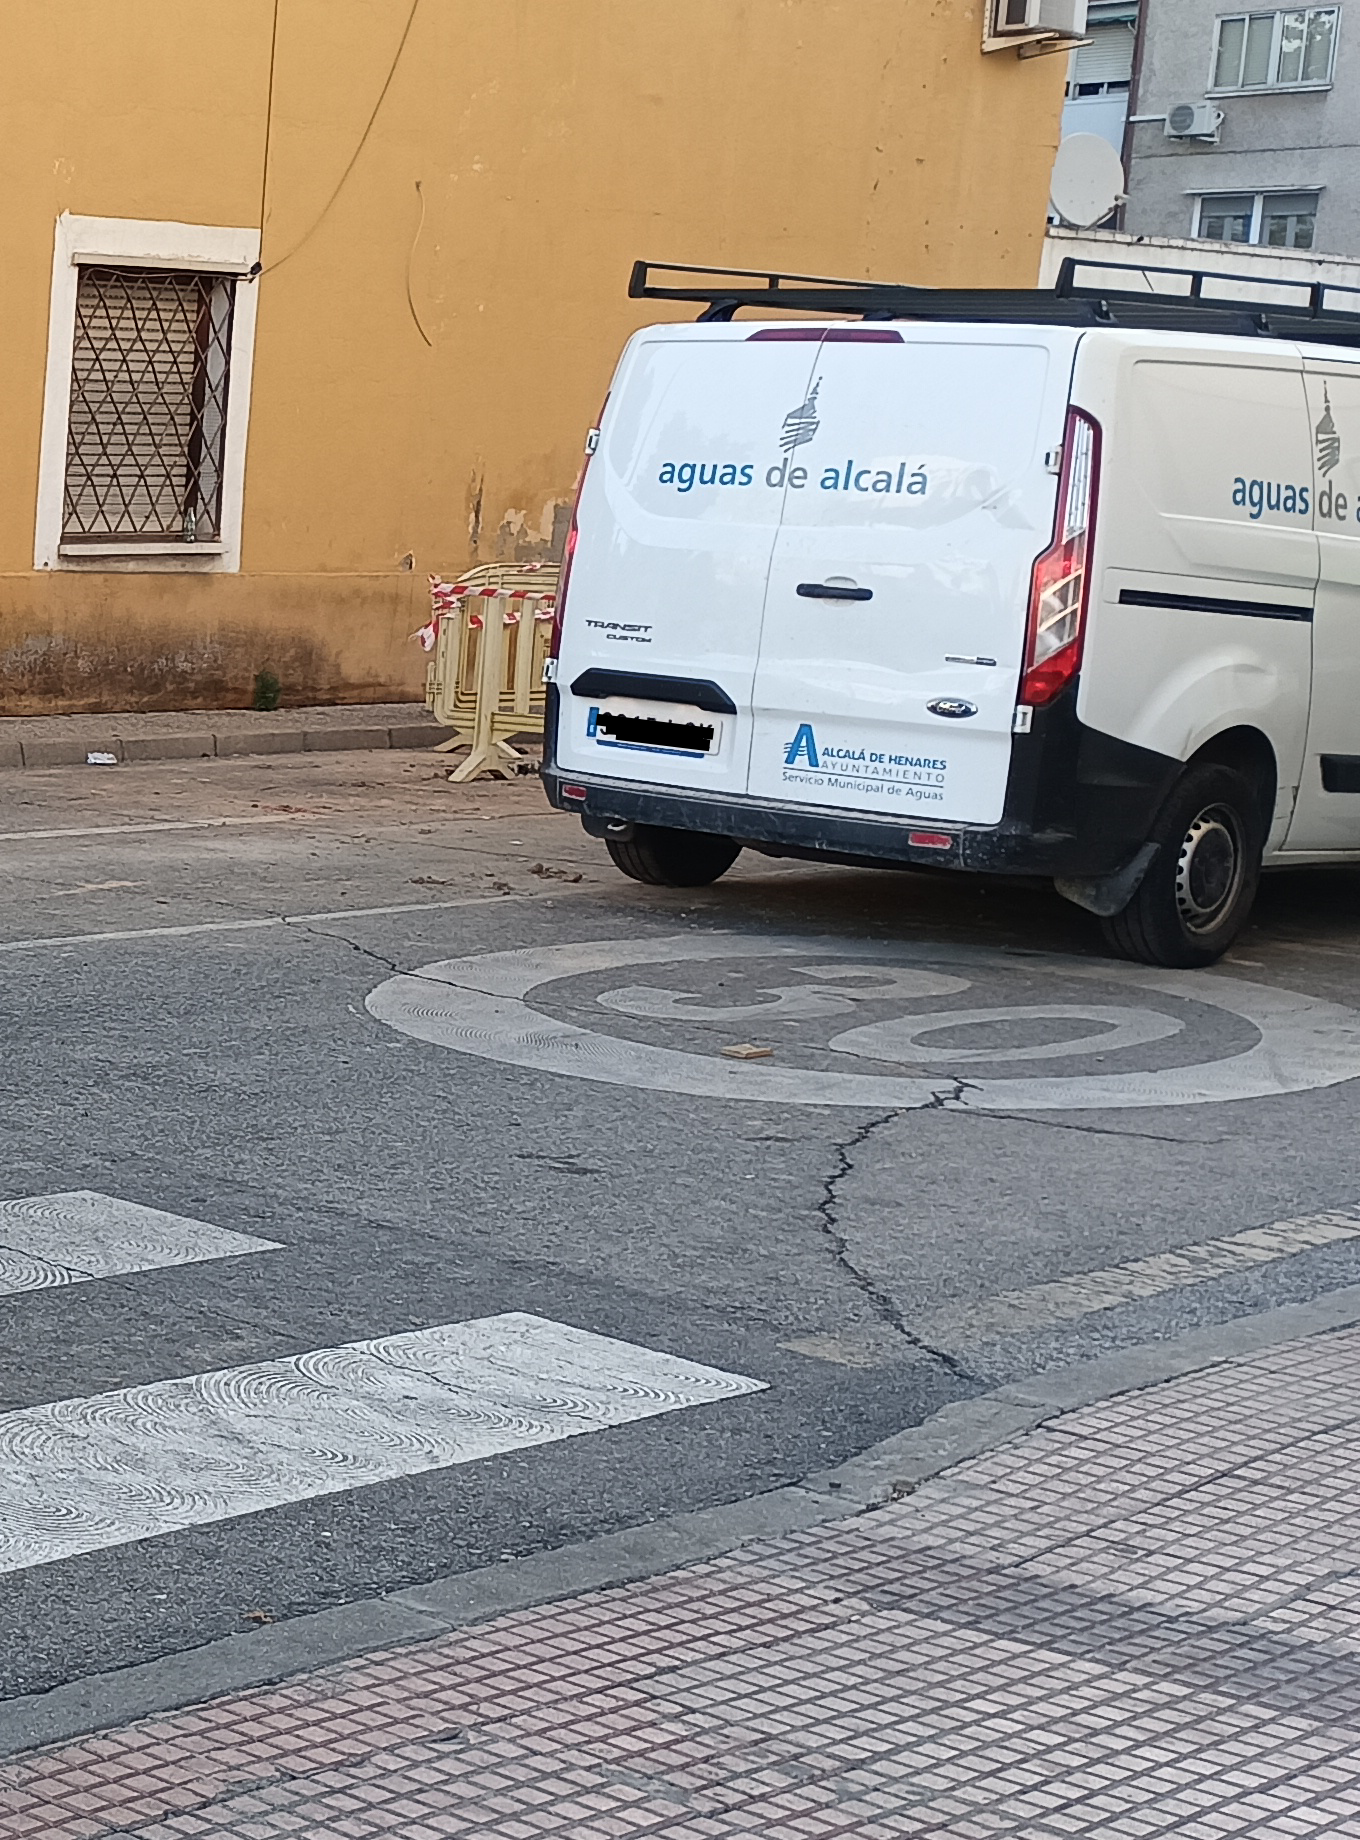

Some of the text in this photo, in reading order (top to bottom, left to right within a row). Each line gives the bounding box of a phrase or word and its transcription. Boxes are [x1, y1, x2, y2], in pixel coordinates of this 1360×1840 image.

[658, 457, 929, 496] aguas de alcalá
[1231, 476, 1310, 520] aguas
[1318, 479, 1349, 522] de
[584, 619, 653, 634] TRANSIT
[606, 633, 653, 644] CUSTOM
[820, 760, 946, 783] AYUNTAMIENTO
[821, 746, 948, 771] ALCALÁ DE HENARES
[782, 771, 945, 802] Servicio Municipal de Aguas
[596, 964, 1186, 1064] 30
